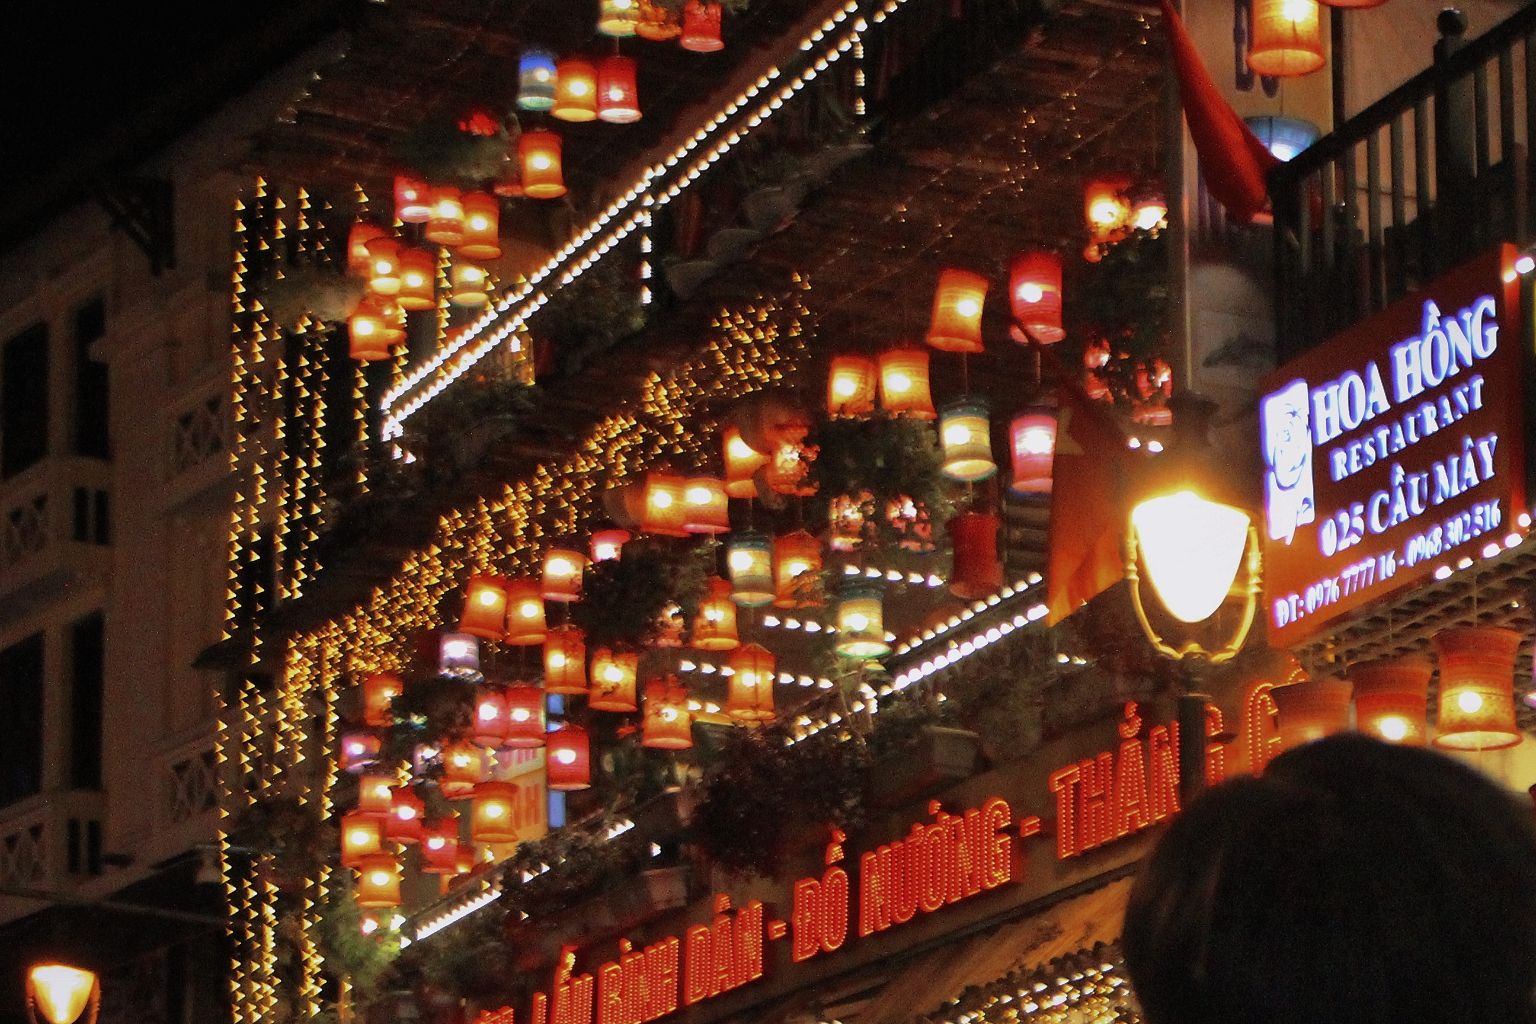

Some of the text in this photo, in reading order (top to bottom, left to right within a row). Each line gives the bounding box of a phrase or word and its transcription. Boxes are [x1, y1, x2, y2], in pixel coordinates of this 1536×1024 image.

[1310, 295, 1499, 446] HOA HỒNG
[1330, 374, 1484, 481] RESTAURANT
[1318, 432, 1498, 557] 025 CẦU MÂY
